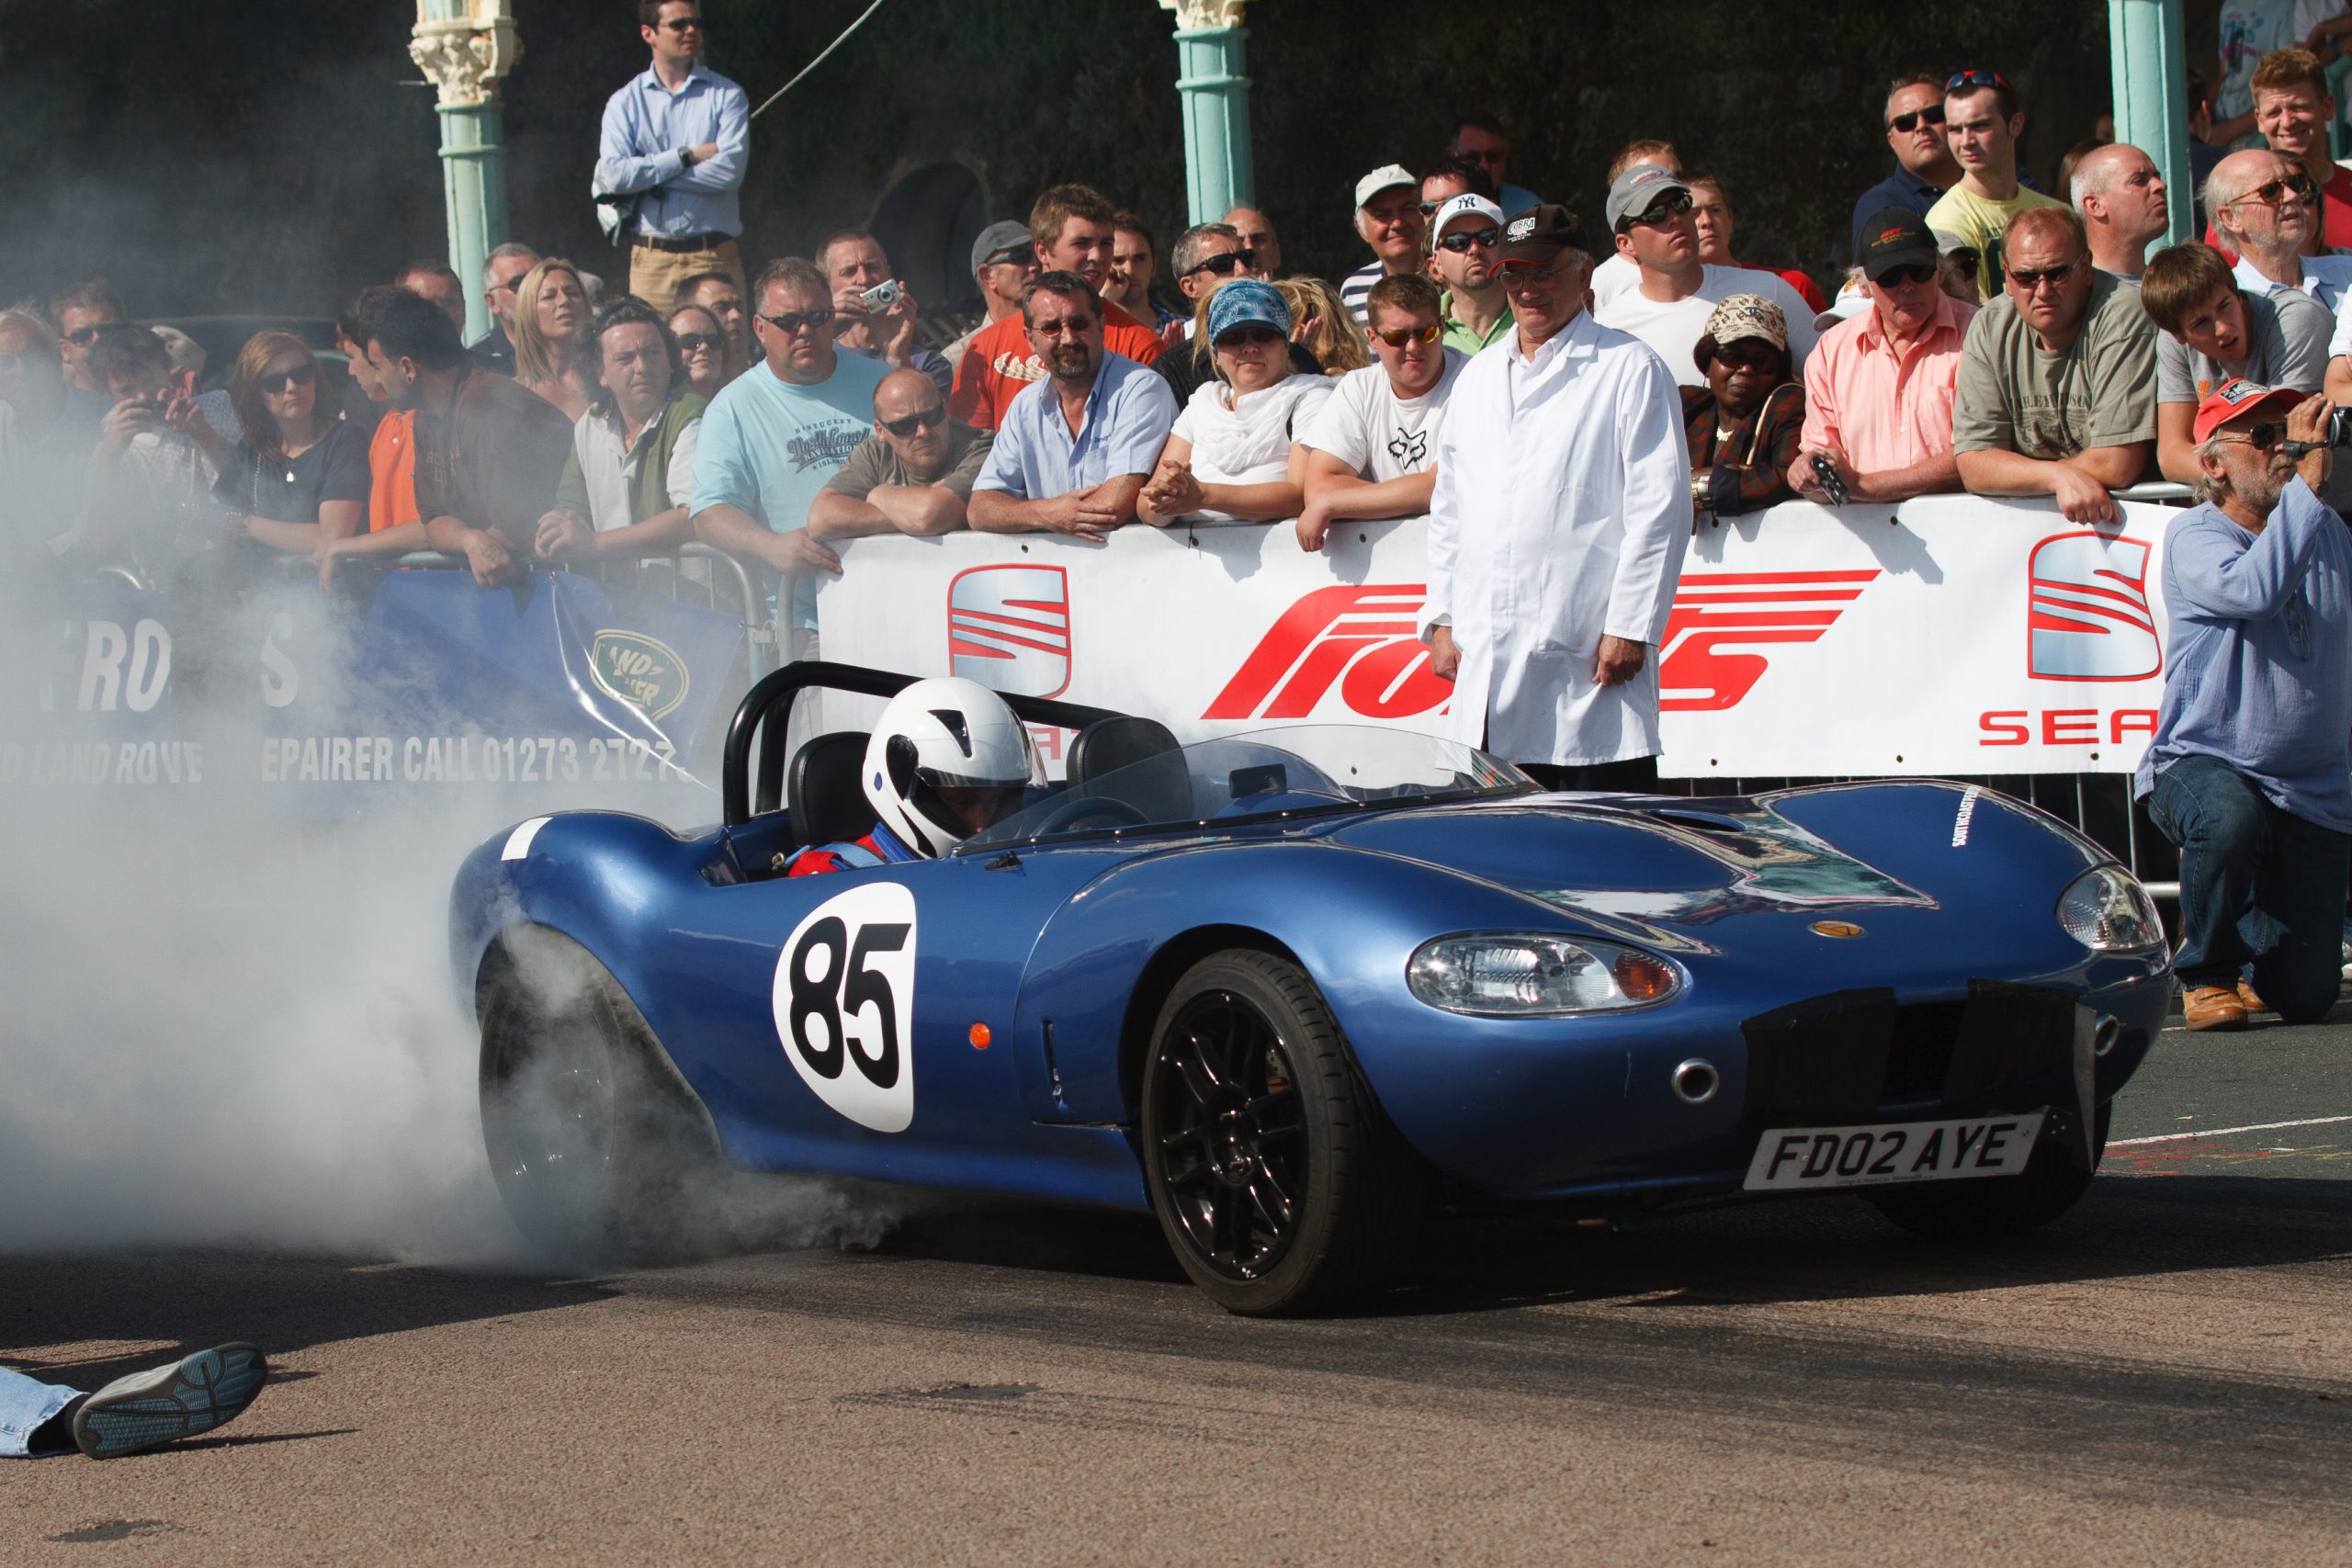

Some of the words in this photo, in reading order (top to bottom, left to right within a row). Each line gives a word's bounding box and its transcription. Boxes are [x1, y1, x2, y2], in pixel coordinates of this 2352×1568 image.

[1508, 218, 1535, 235] COBRA
[1979, 709, 2159, 746] SEA
[115, 740, 203, 784] ROVE
[261, 735, 394, 782] EPAIRER
[403, 736, 476, 781] CALL
[482, 736, 581, 781] 01273
[790, 916, 912, 1089] 85
[1765, 1130, 1908, 1180] FD02
[1910, 1122, 2018, 1173] AYE
